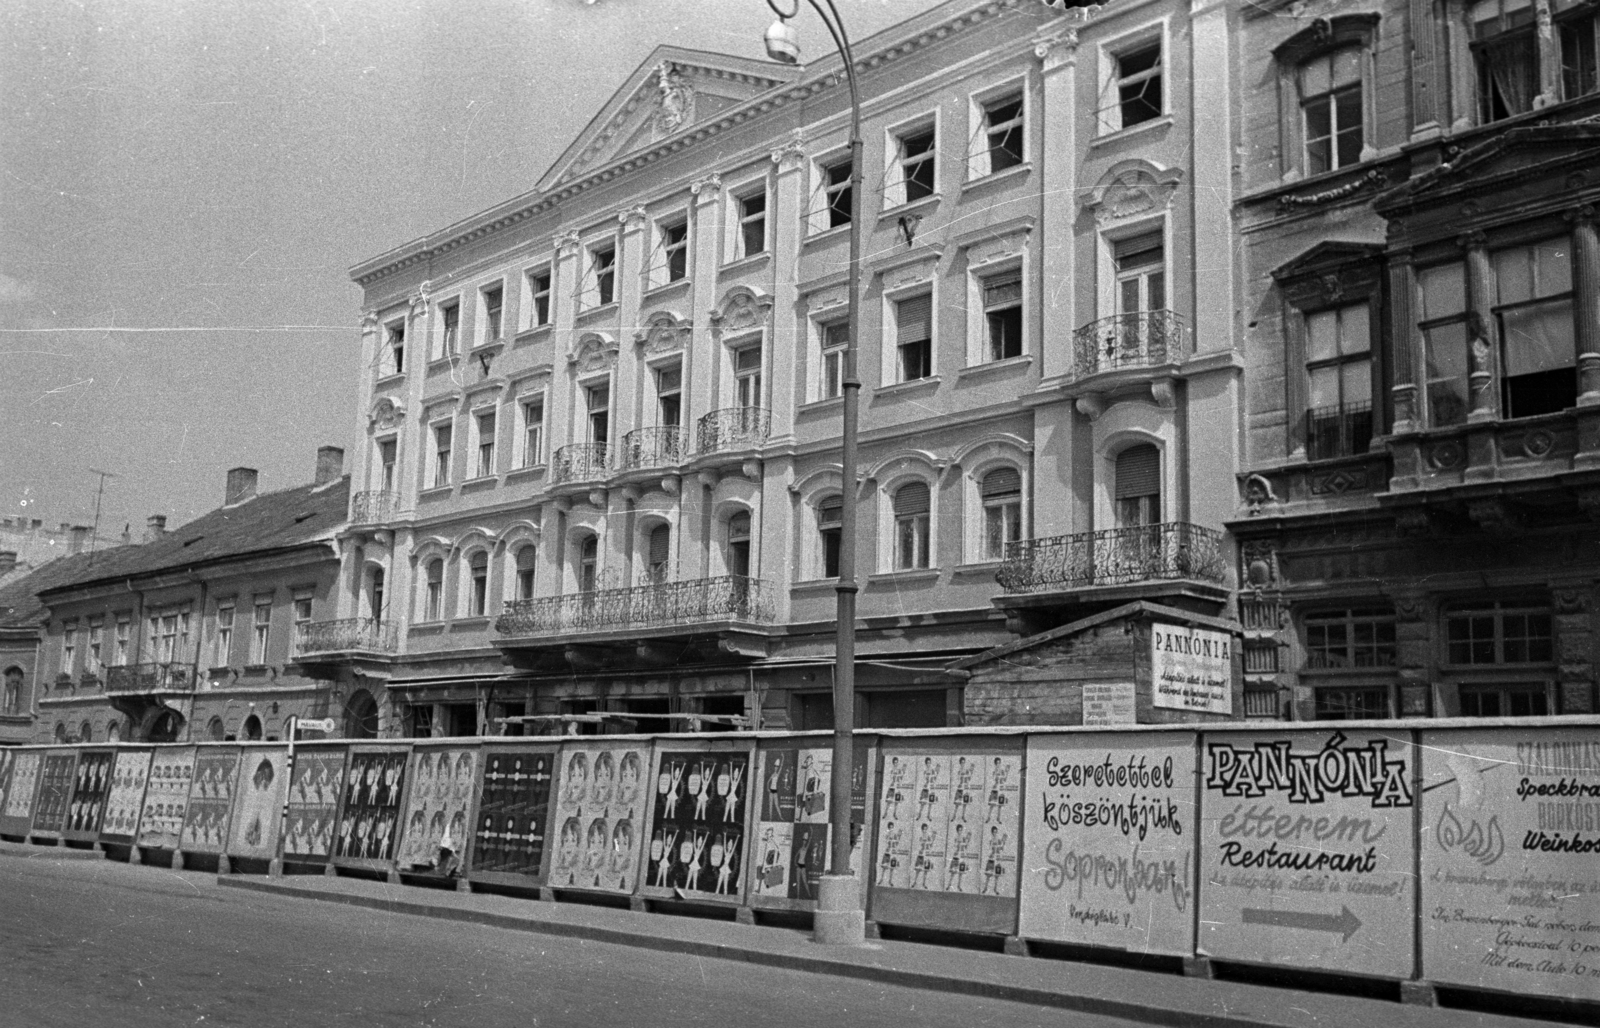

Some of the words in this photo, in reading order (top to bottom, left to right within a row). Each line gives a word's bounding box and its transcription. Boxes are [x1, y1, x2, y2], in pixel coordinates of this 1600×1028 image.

[1155, 632, 1230, 660] PANNÓNIA
[1046, 753, 1174, 788] Szeretettel
[1207, 731, 1414, 808] PANNÓNIA
[1043, 792, 1182, 841] köszöntjük
[1219, 804, 1387, 844] étterem
[1045, 838, 1190, 913] Sopronban!
[1219, 842, 1376, 873] Restaurant
